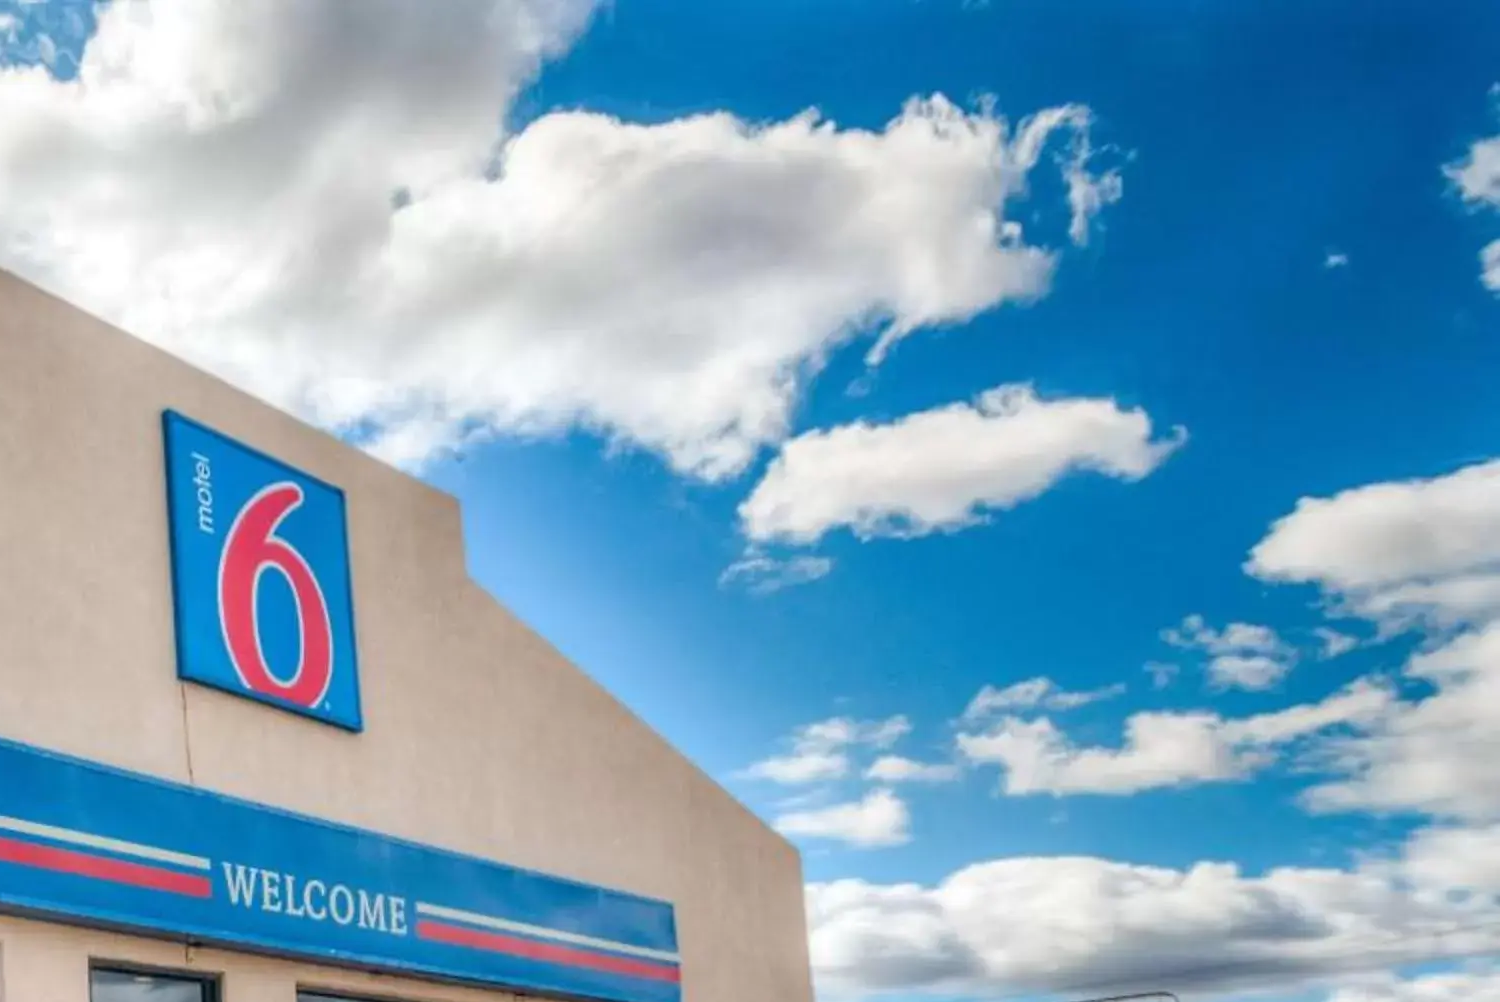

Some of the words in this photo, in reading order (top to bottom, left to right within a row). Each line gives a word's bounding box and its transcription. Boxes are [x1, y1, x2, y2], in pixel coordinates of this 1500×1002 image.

[191, 452, 215, 534] motel
[217, 481, 334, 708] 6
[222, 861, 408, 935] WELCOME
